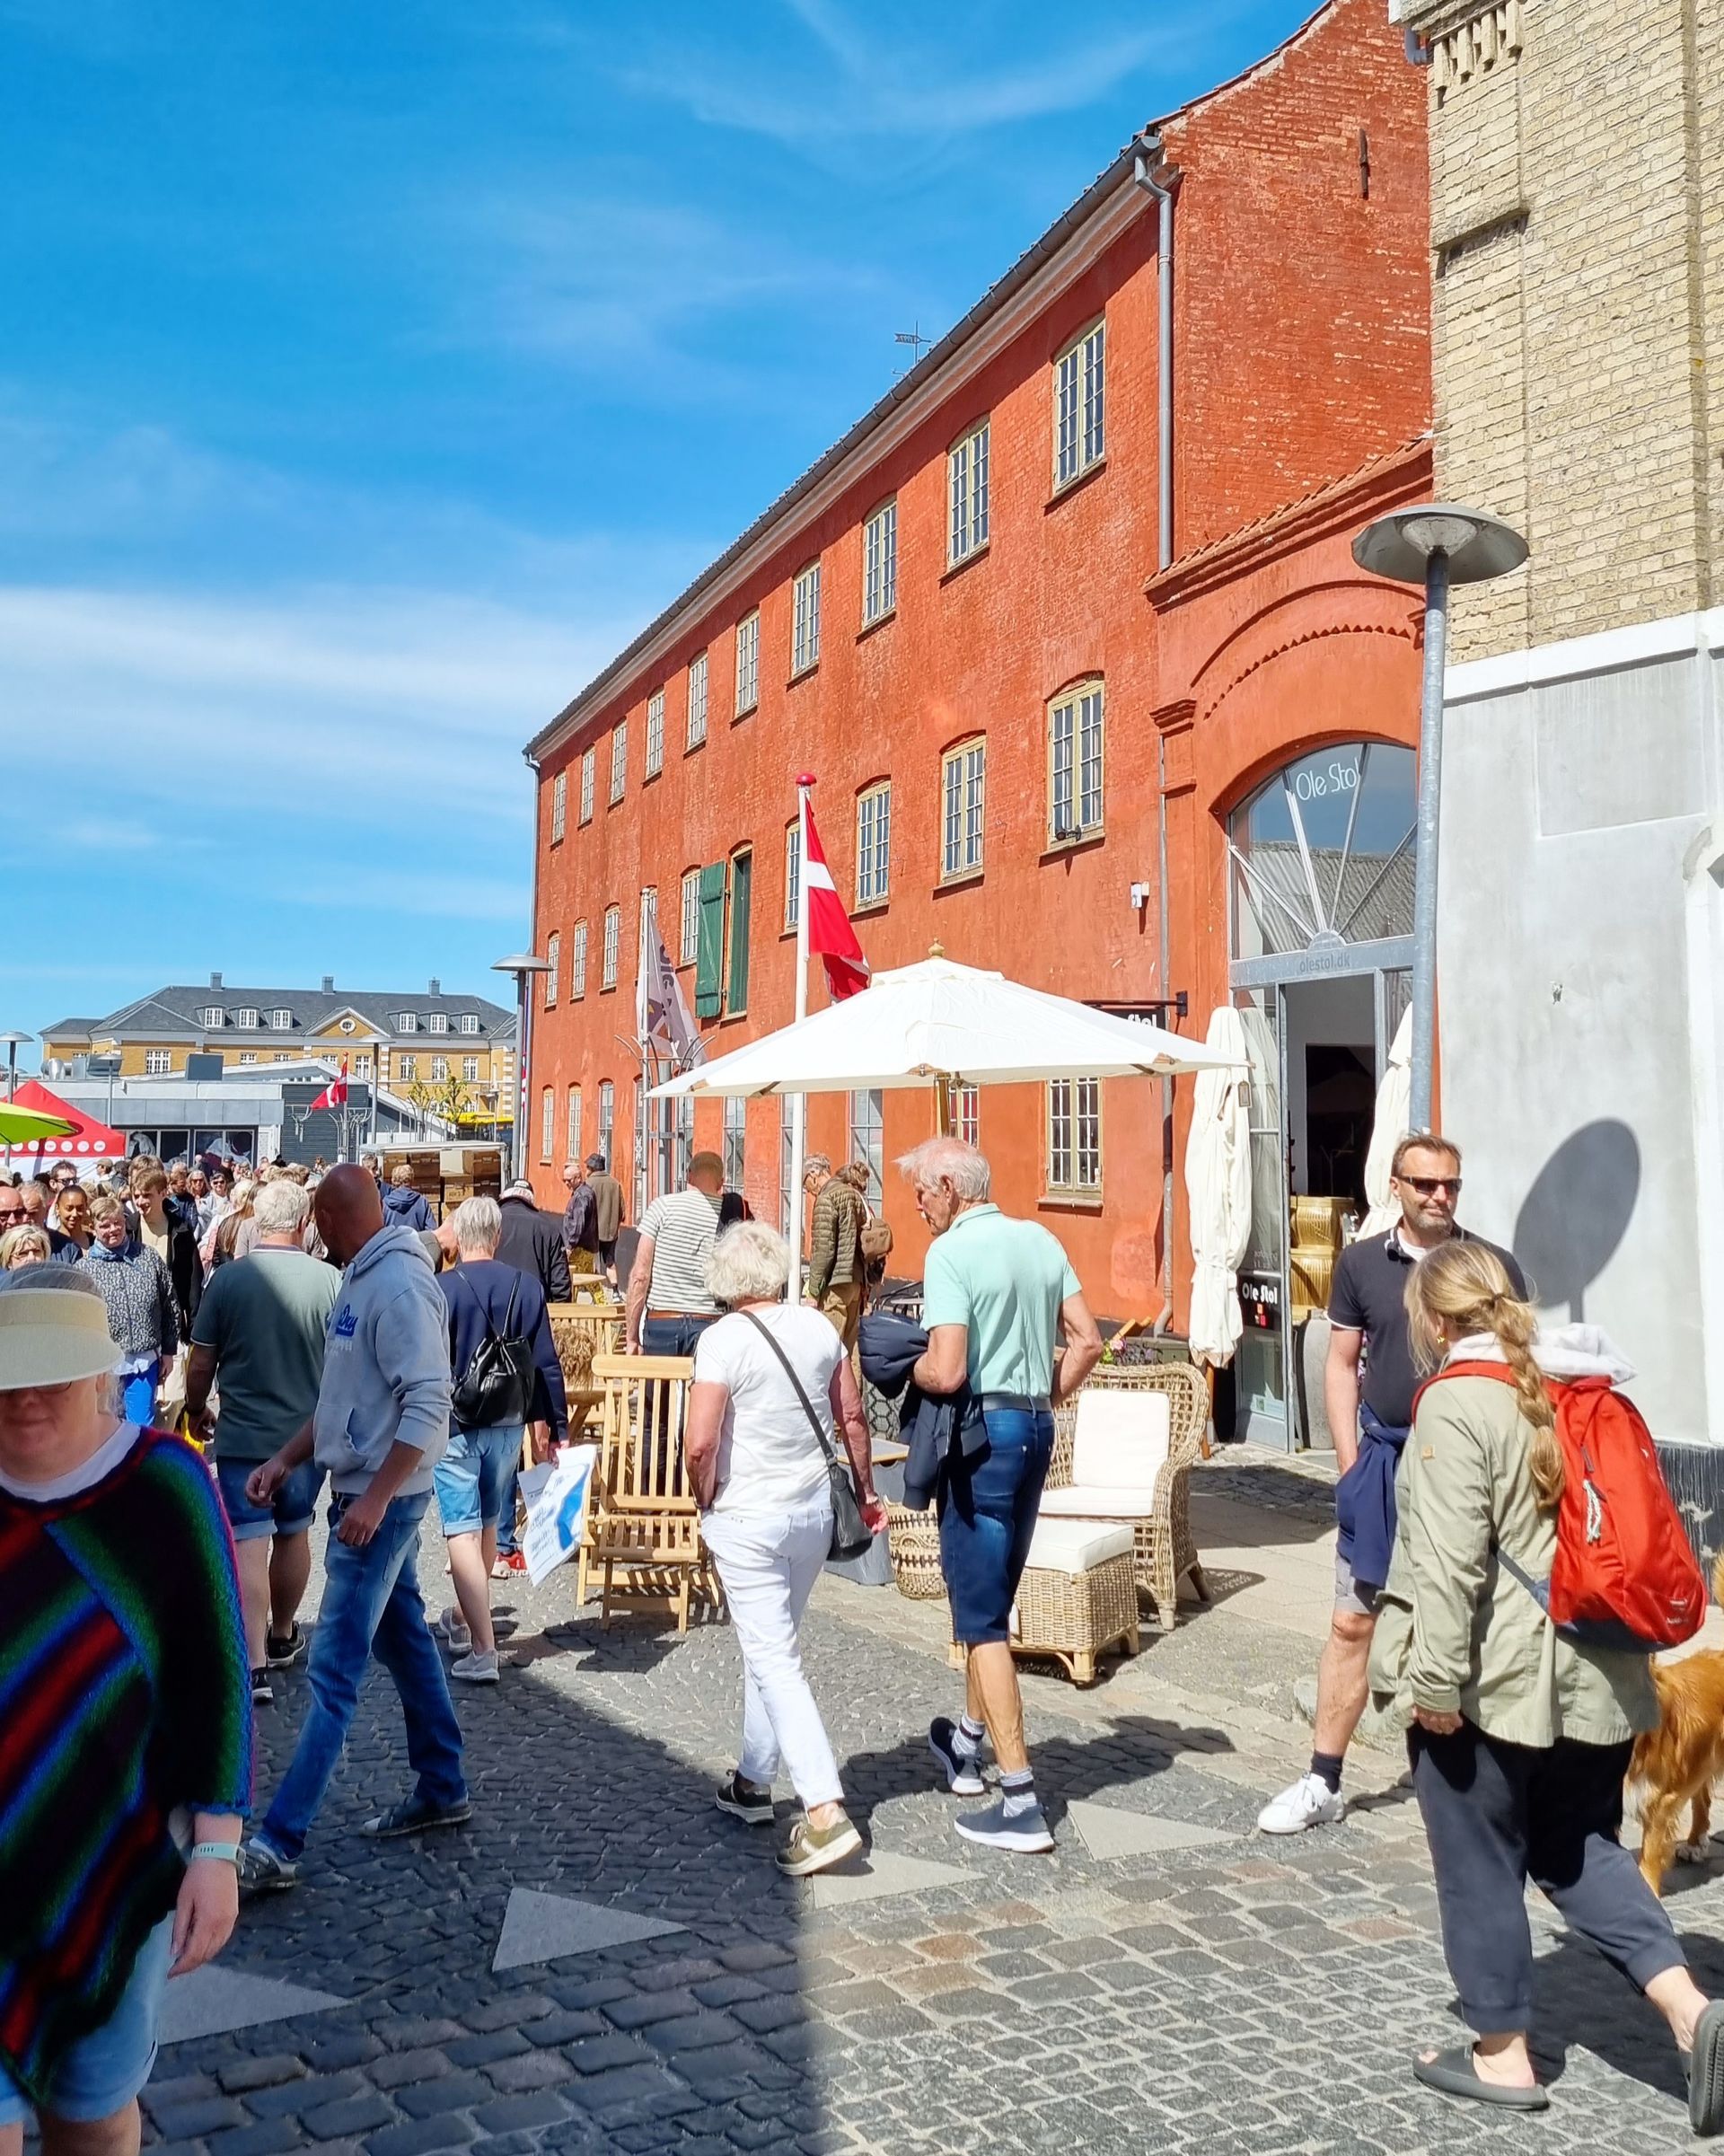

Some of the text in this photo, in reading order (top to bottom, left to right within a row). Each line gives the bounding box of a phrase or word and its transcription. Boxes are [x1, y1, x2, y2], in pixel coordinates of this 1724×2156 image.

[1296, 757, 1359, 801] Ole Stol
[1299, 953, 1350, 972] olestol.dk
[1242, 1281, 1278, 1305] Ole Stol
